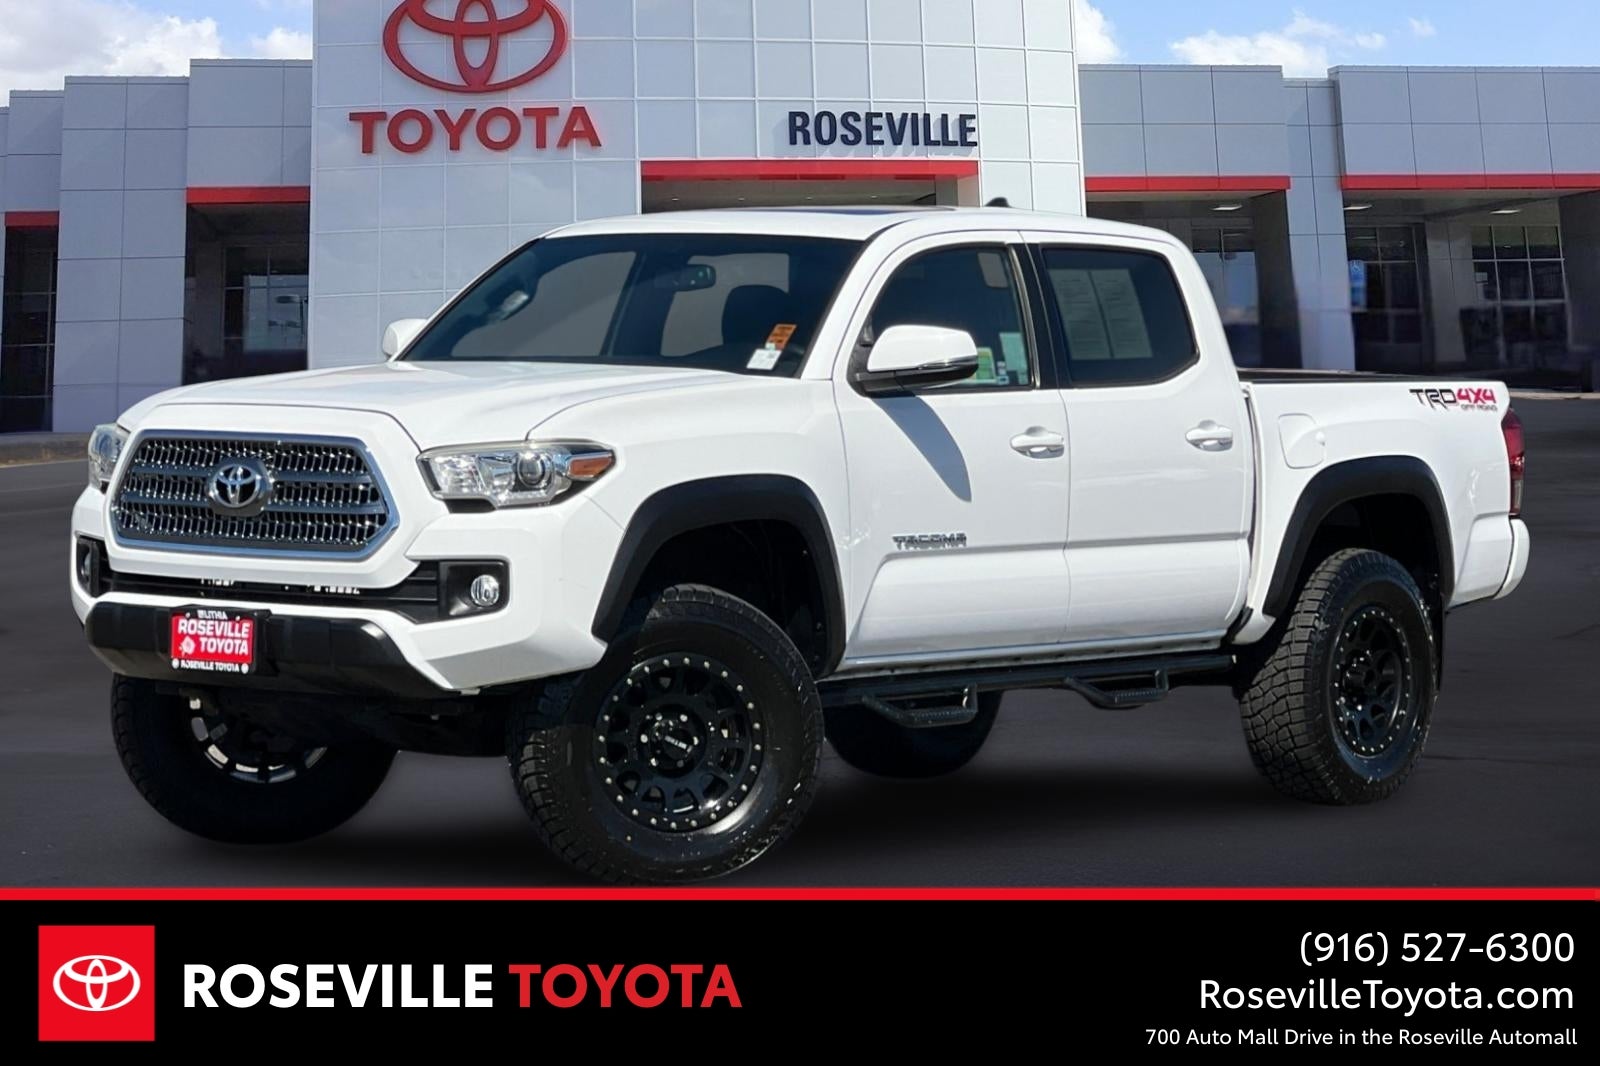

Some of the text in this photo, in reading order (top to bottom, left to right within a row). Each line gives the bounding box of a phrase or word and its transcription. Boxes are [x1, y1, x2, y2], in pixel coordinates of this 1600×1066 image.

[349, 107, 602, 154] TOYOTA
[789, 111, 977, 147] ROSEVILLE
[1409, 388, 1458, 410] TRD
[892, 533, 967, 550] TACOMA
[177, 619, 250, 638] ROSEVILLE
[199, 637, 249, 655] TOYOTA
[180, 660, 239, 672] ROSEVILLE TOYOTA
